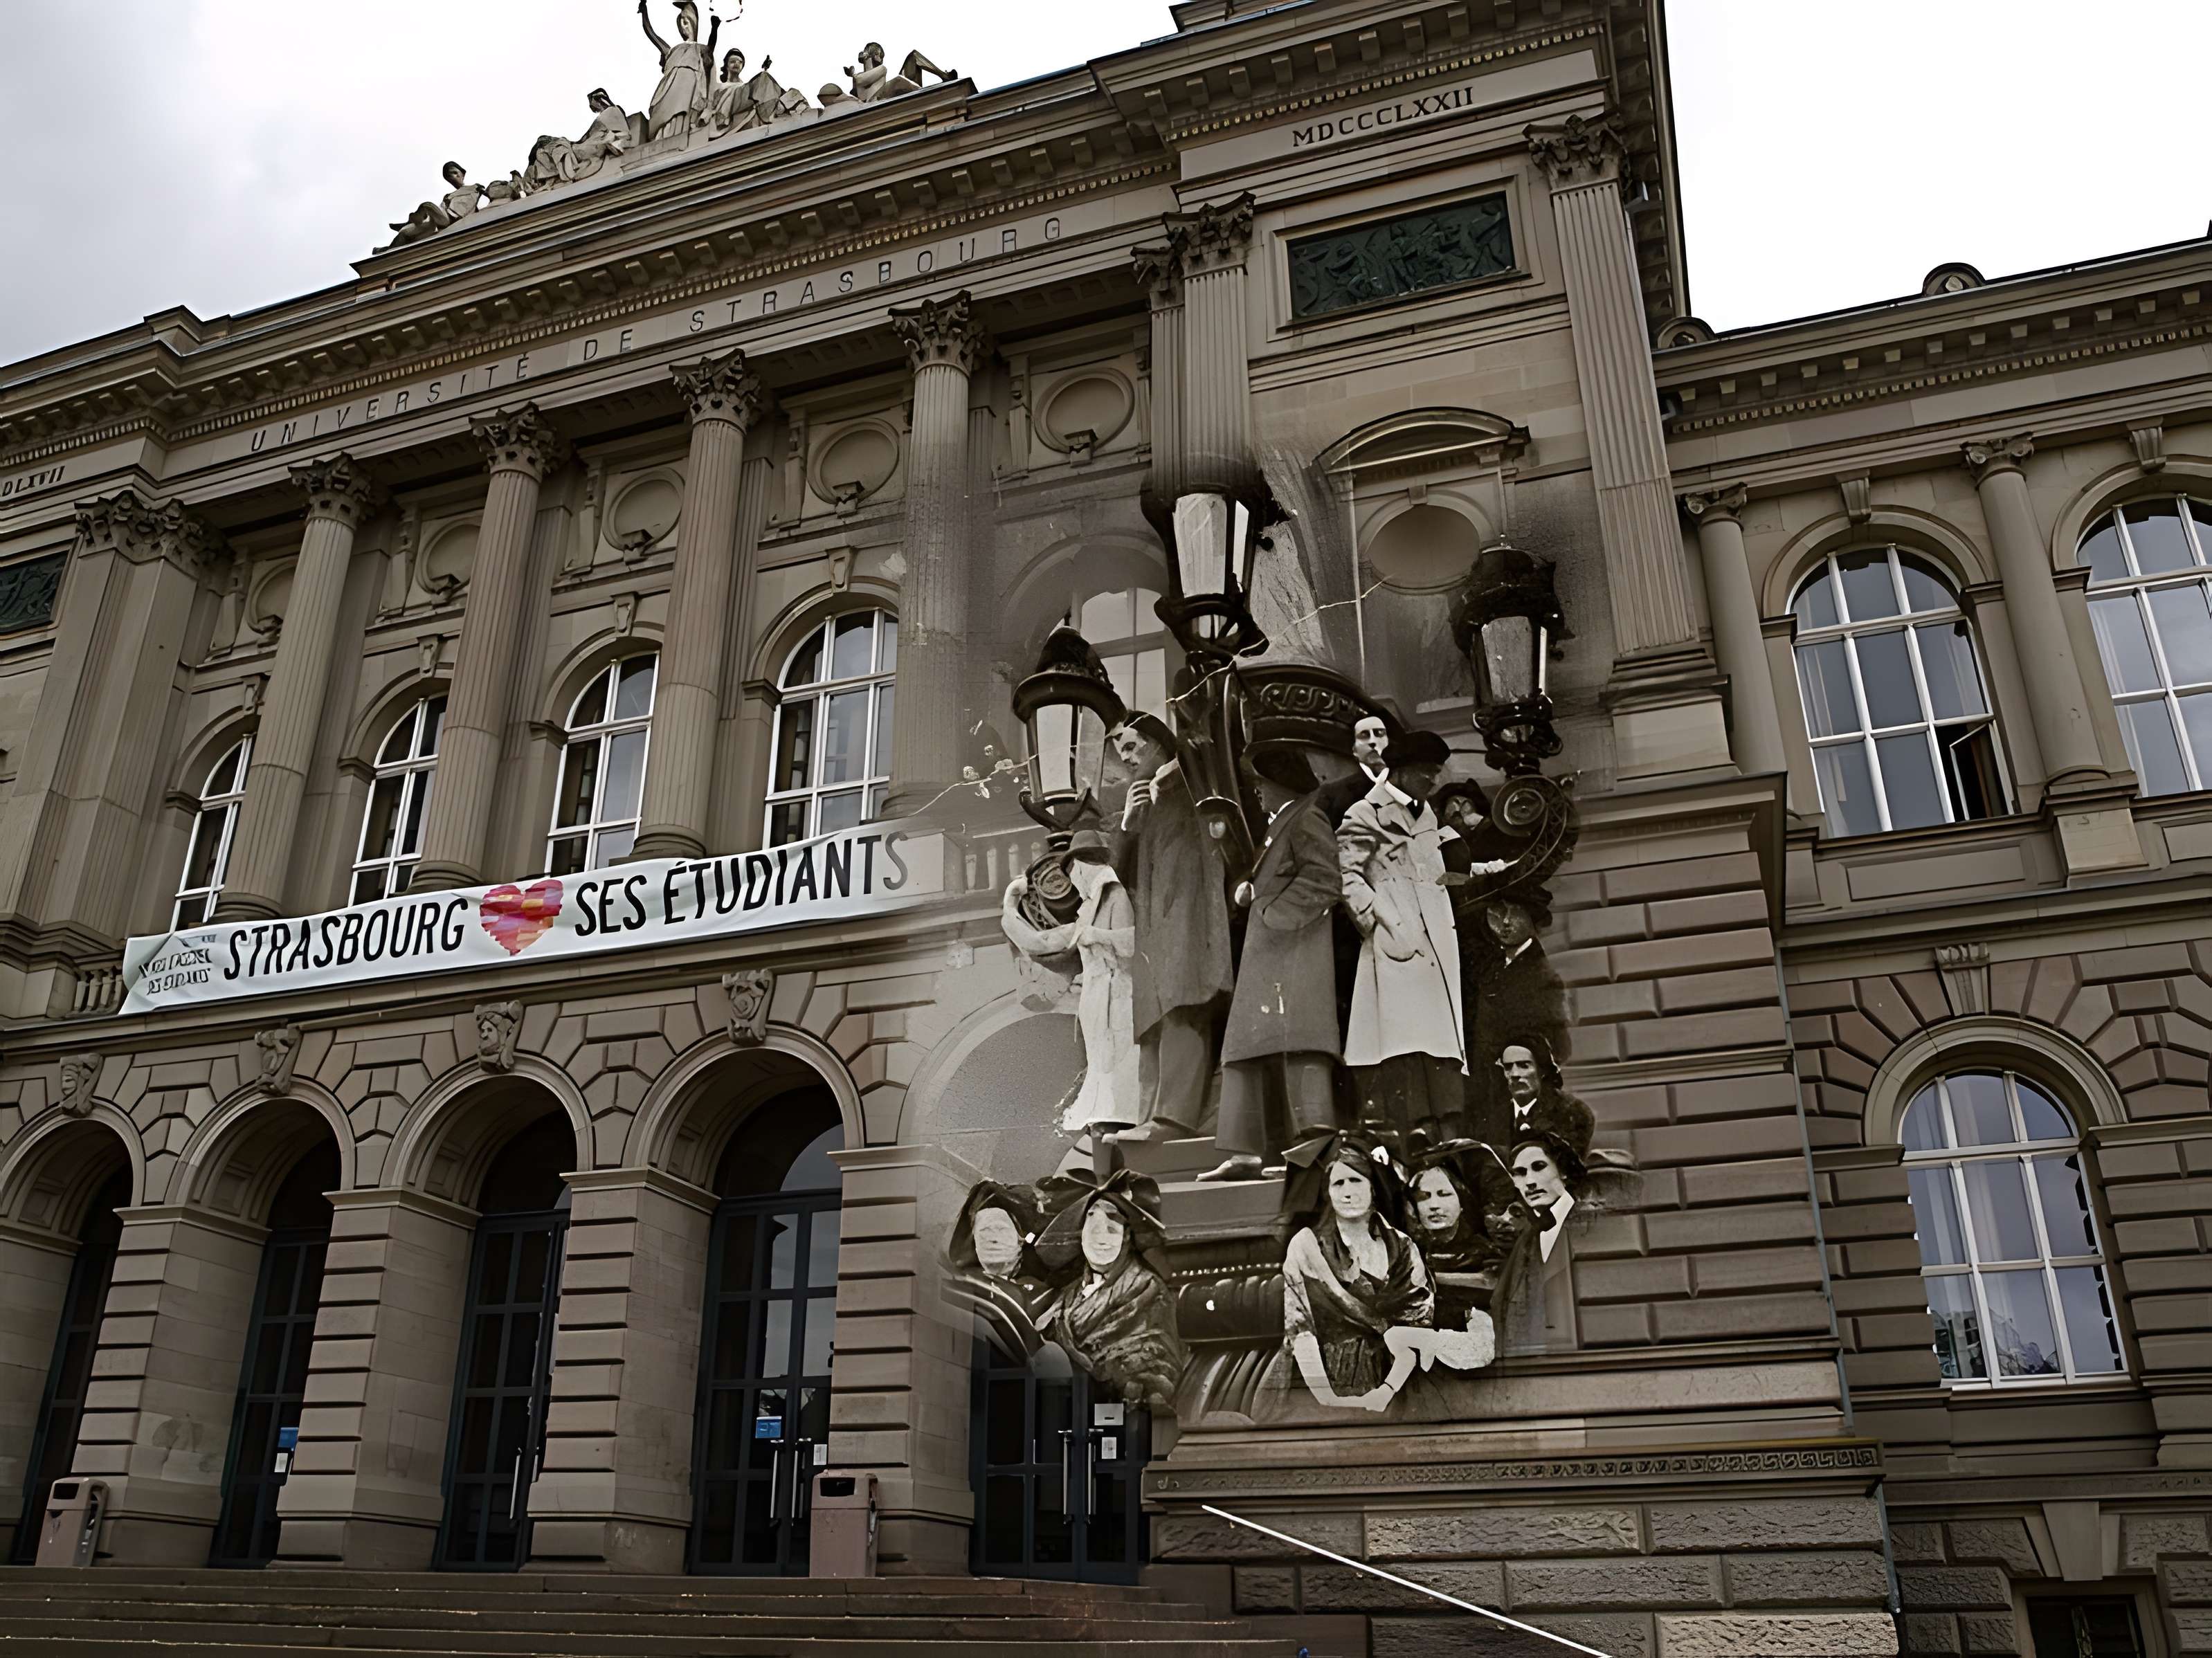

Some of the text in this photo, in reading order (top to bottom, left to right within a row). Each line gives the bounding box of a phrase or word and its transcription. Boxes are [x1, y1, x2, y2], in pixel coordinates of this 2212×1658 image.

[1292, 86, 1474, 147] MDCCCLXXII
[250, 217, 1060, 452] UNIVERSITÉ DE STRASBOURG
[223, 831, 908, 980] STRASBOURG SES ÉTUDIANTS
